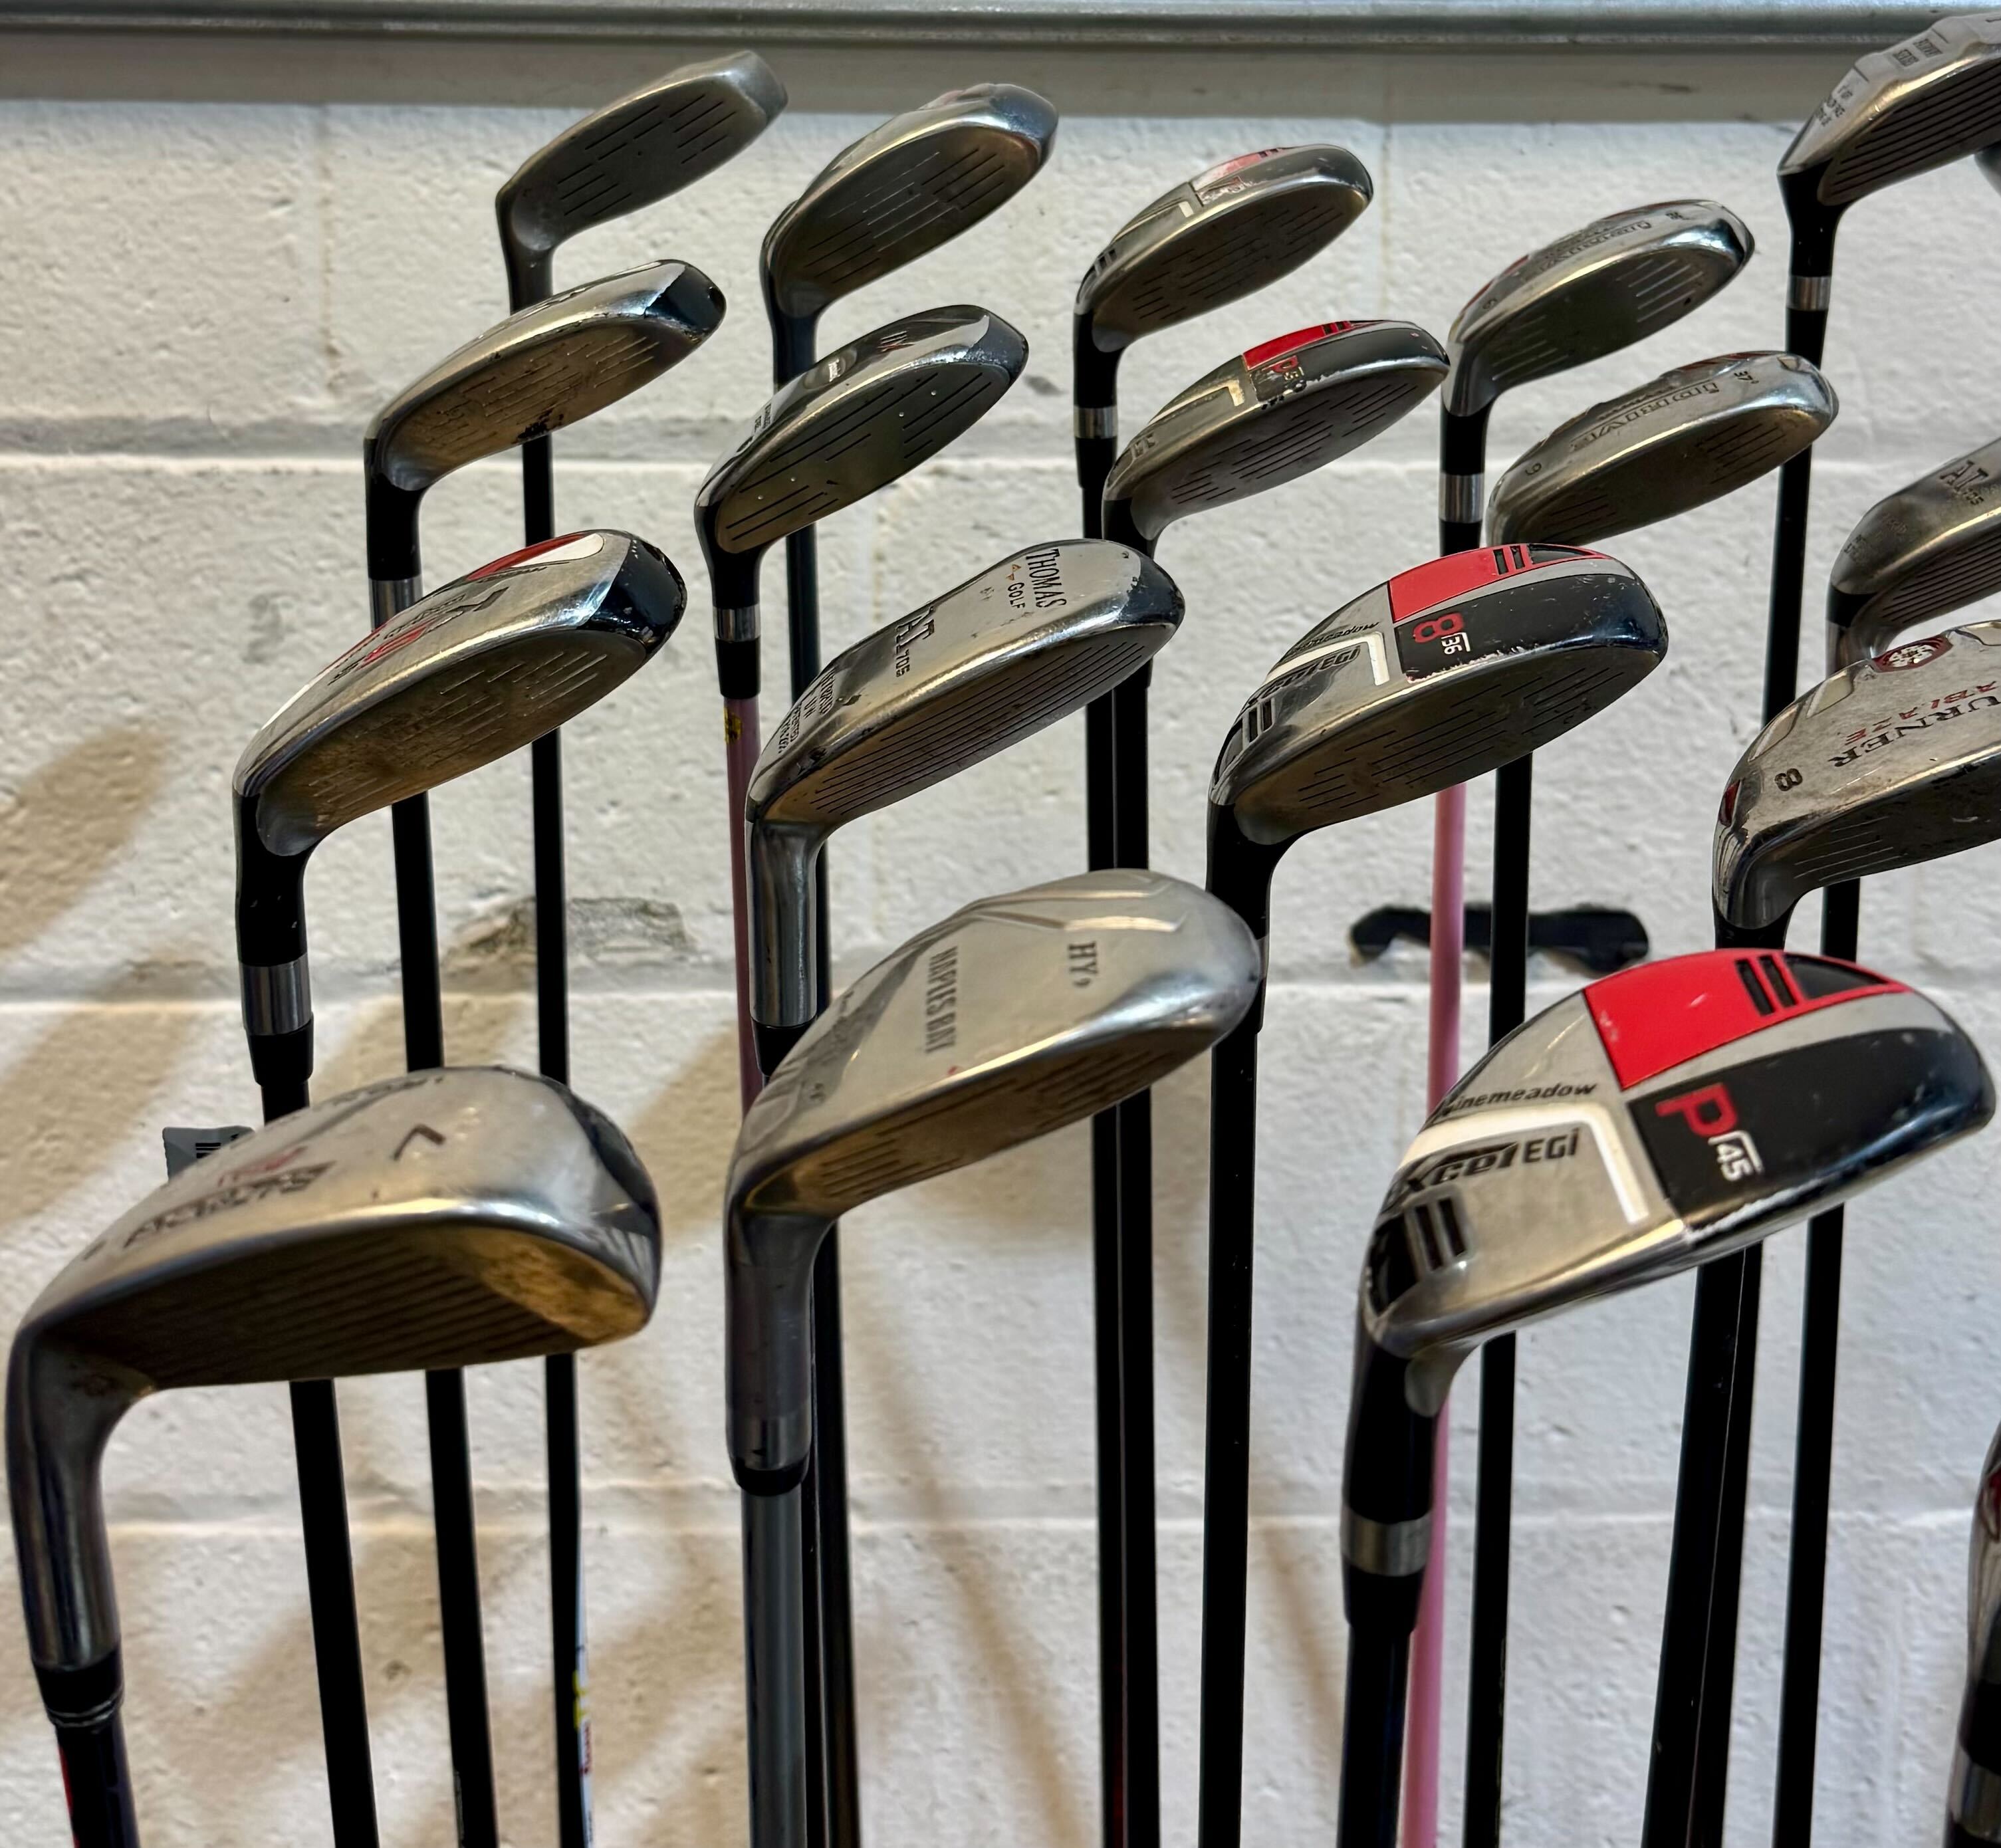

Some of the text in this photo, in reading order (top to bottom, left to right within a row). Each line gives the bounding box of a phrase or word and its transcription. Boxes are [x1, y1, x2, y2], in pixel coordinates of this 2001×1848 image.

[1026, 548, 1067, 608] THOMAS
[1007, 582, 1025, 608] GOLF
[1413, 612, 1466, 644] 8
[1318, 645, 1361, 670] EGI
[1441, 636, 1463, 655] 36
[1774, 768, 1804, 792] 8
[1655, 1083, 1738, 1137] P
[1522, 1127, 1581, 1163] EGI
[1717, 1142, 1754, 1181] 45
